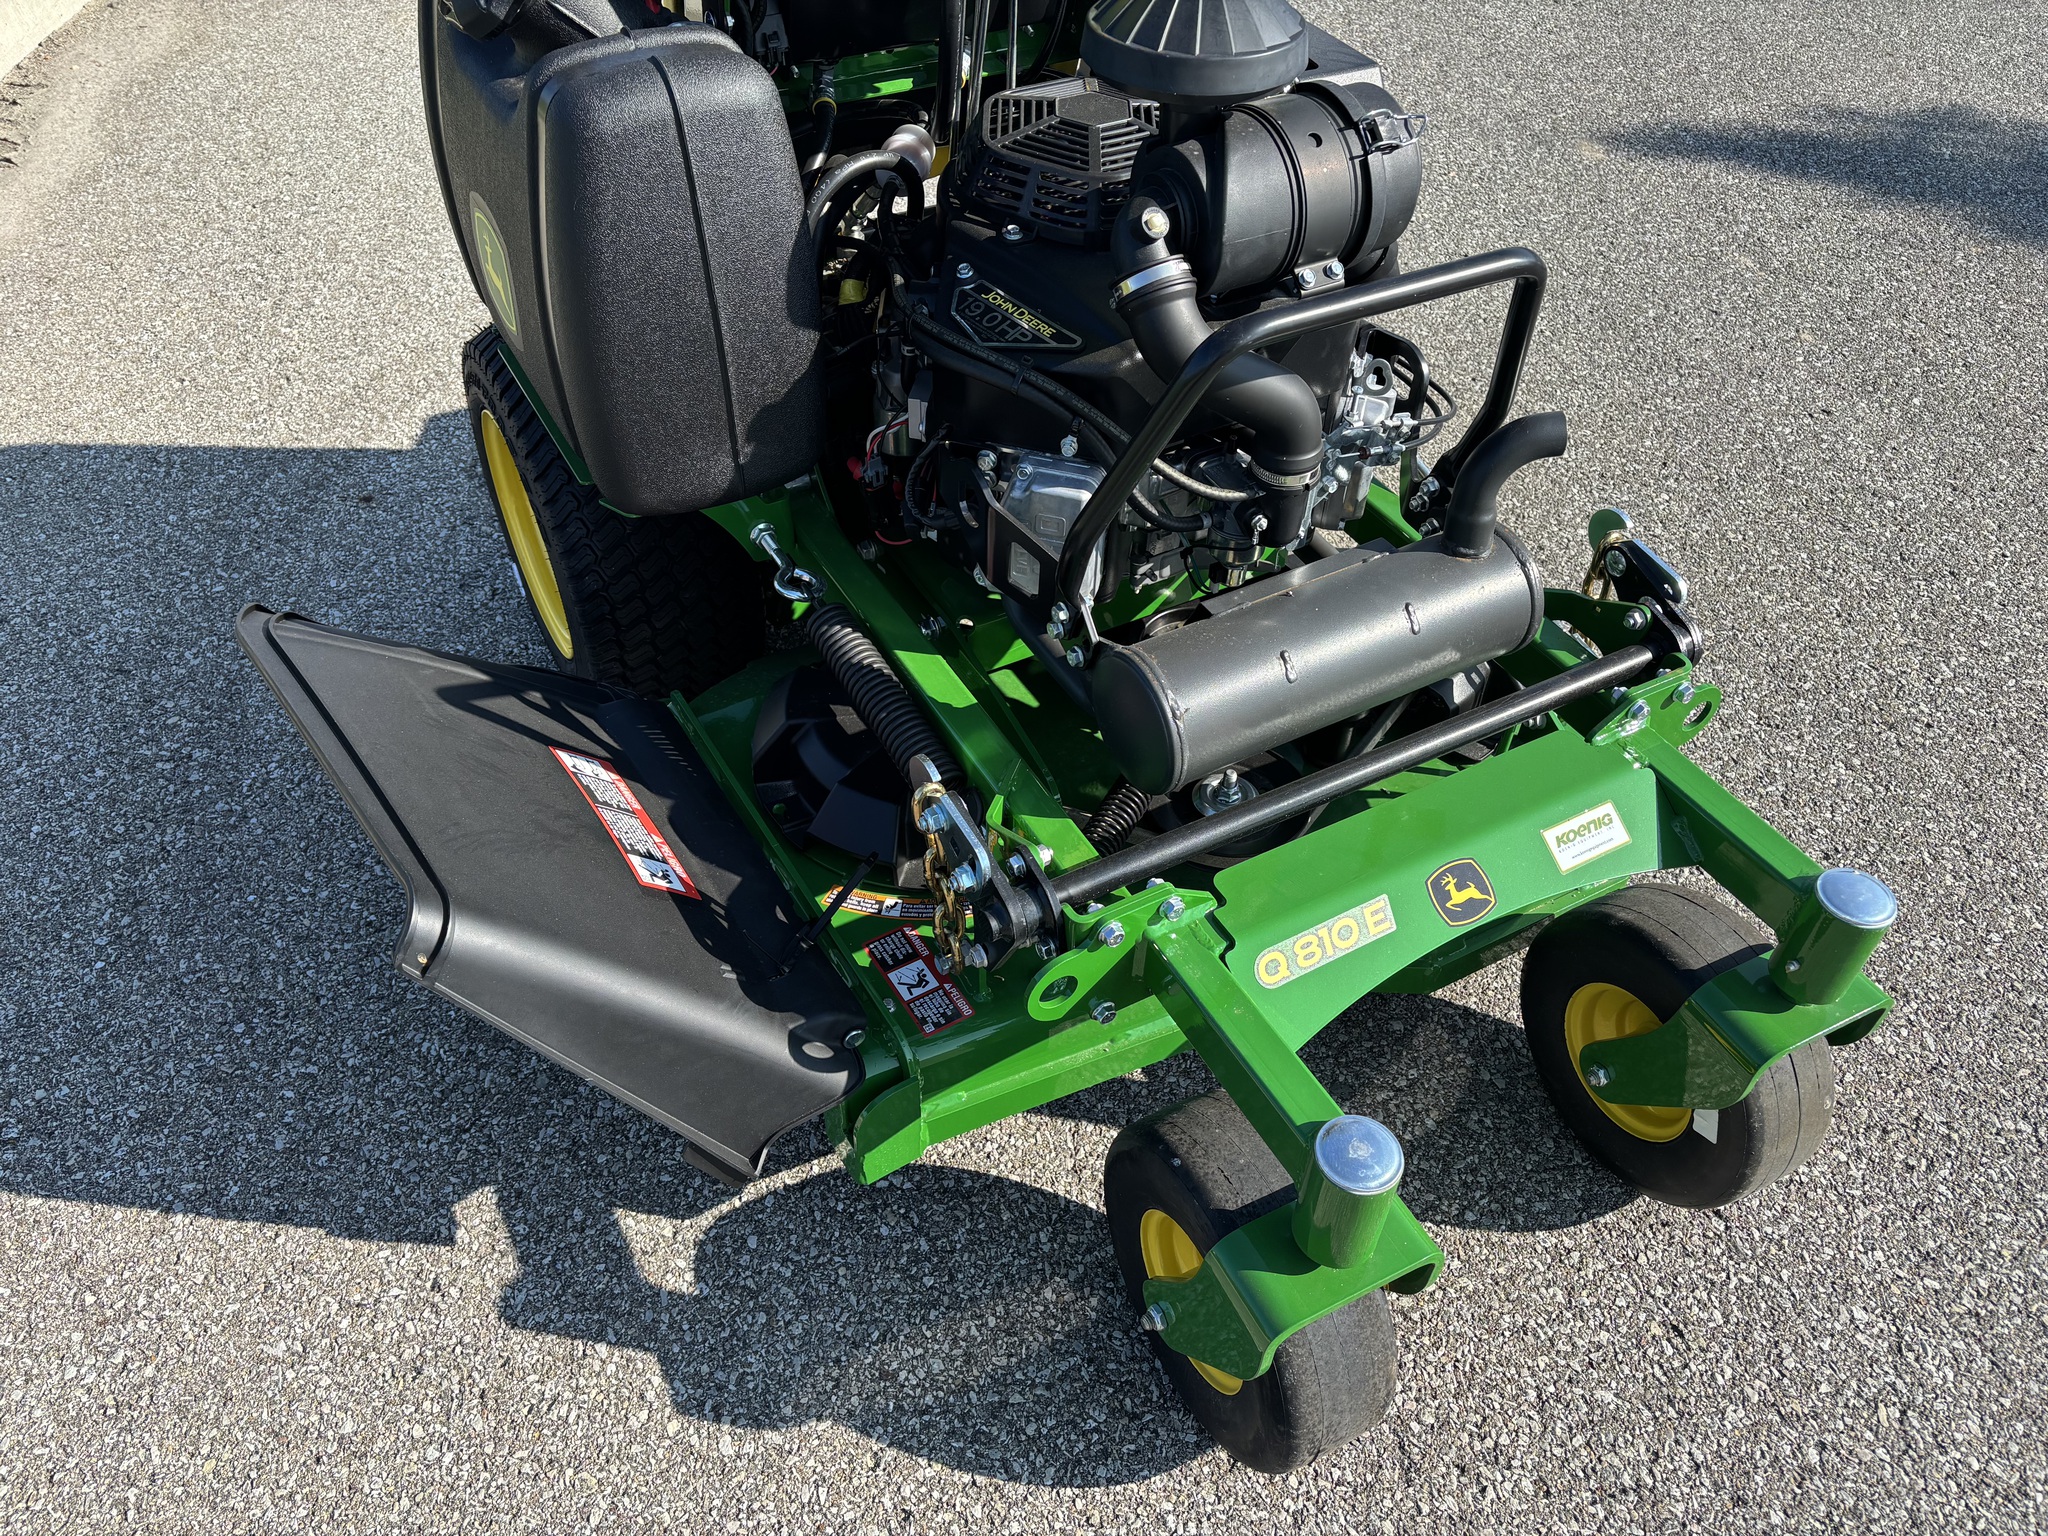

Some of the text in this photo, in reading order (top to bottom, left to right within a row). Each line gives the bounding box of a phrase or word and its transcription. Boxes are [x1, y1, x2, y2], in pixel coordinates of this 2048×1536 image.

[959, 297, 1002, 327] 19.0
[996, 318, 1033, 342] HP
[981, 290, 1017, 313] JOHN
[1013, 309, 1057, 338] DEERE
[906, 930, 930, 957] DANGER
[1258, 899, 1393, 985] Q 810 E
[946, 987, 973, 1016] PELIGRO
